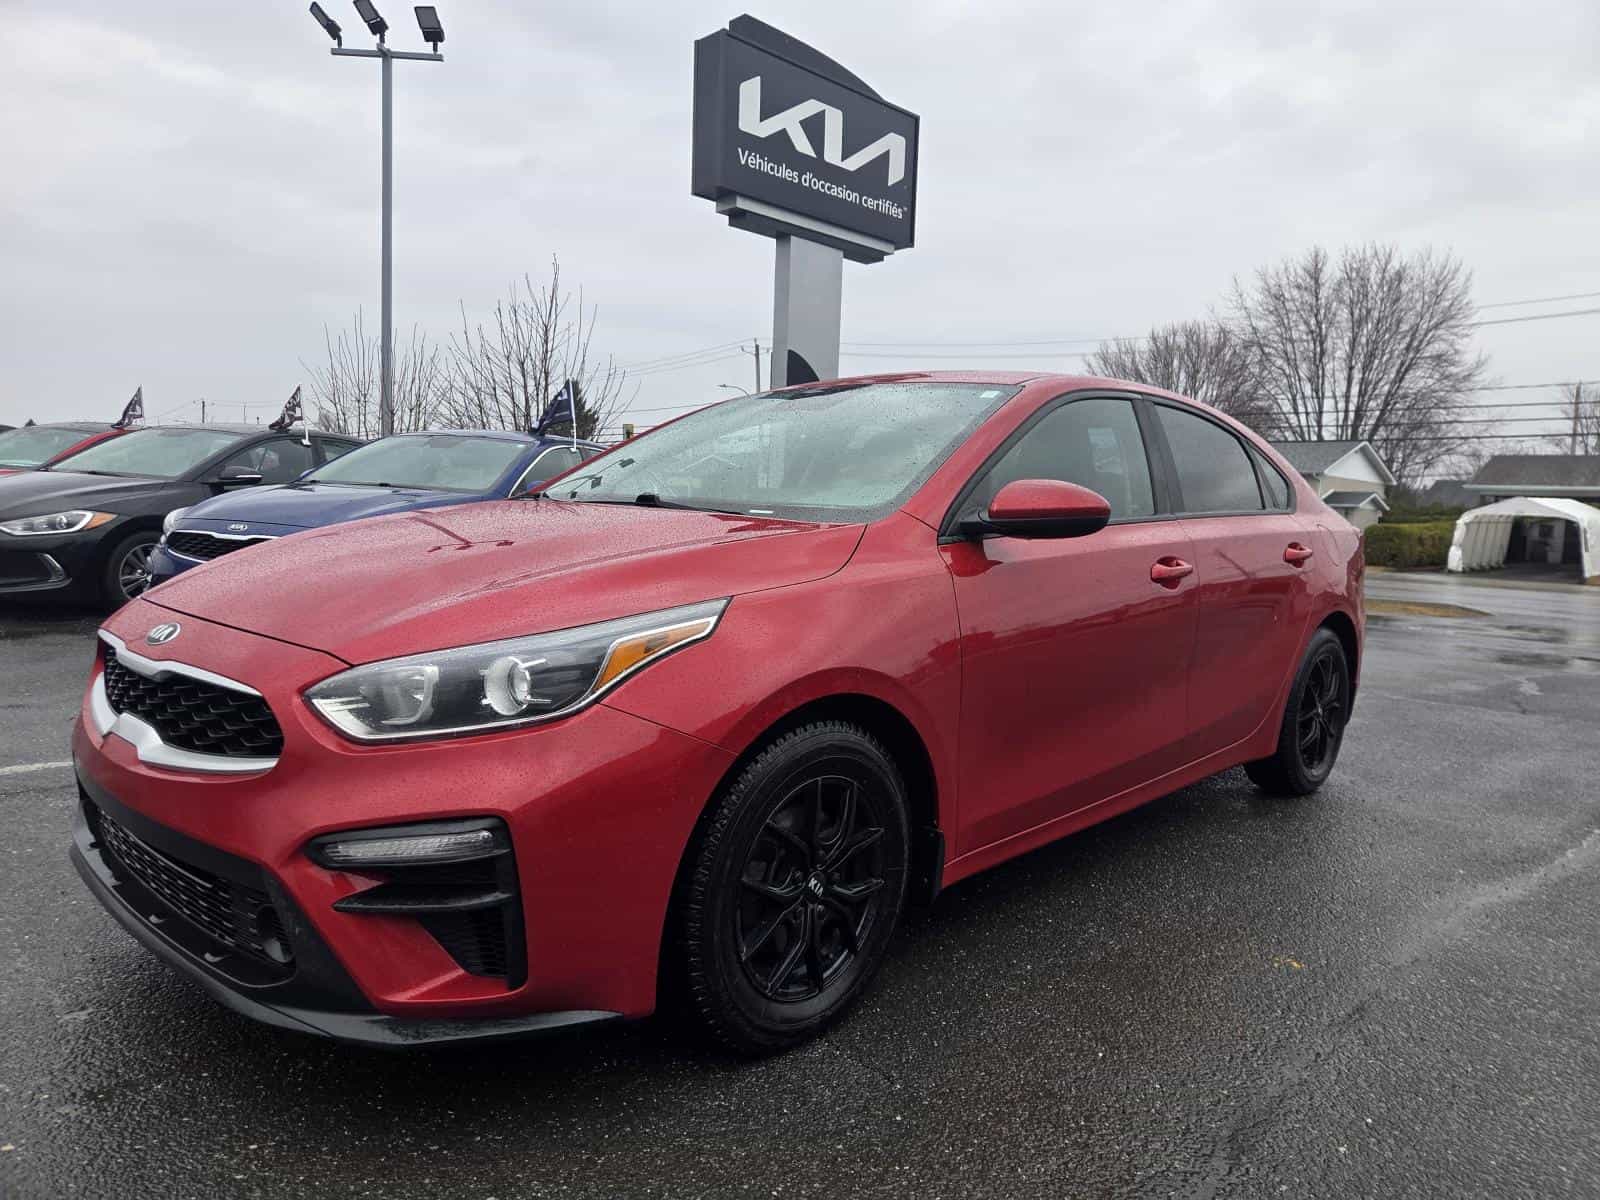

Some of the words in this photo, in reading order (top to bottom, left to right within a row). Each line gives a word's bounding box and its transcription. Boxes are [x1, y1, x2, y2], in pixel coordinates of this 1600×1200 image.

[738, 147, 799, 184] Véhicules
[801, 172, 860, 205] d'occasion
[861, 194, 903, 219] certifiés
[808, 877, 824, 897] KIA
